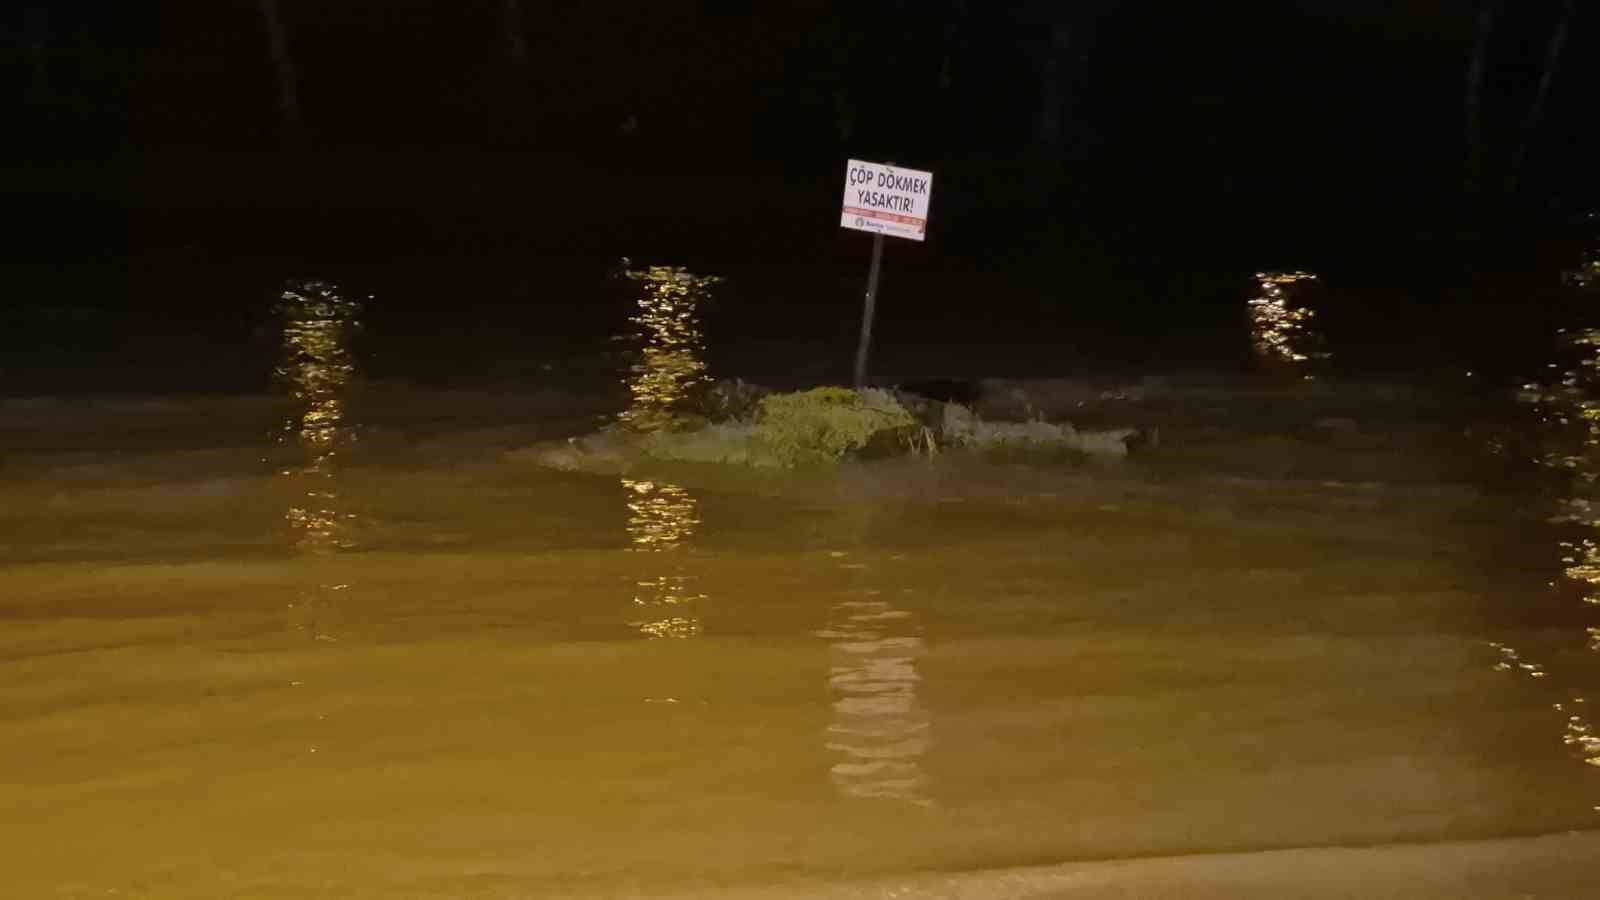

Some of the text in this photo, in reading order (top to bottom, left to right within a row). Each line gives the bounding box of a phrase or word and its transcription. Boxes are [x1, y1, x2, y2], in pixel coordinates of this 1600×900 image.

[850, 165, 927, 194] ÇÖP DÖKMEK
[857, 190, 914, 214] YASAKTIR!
